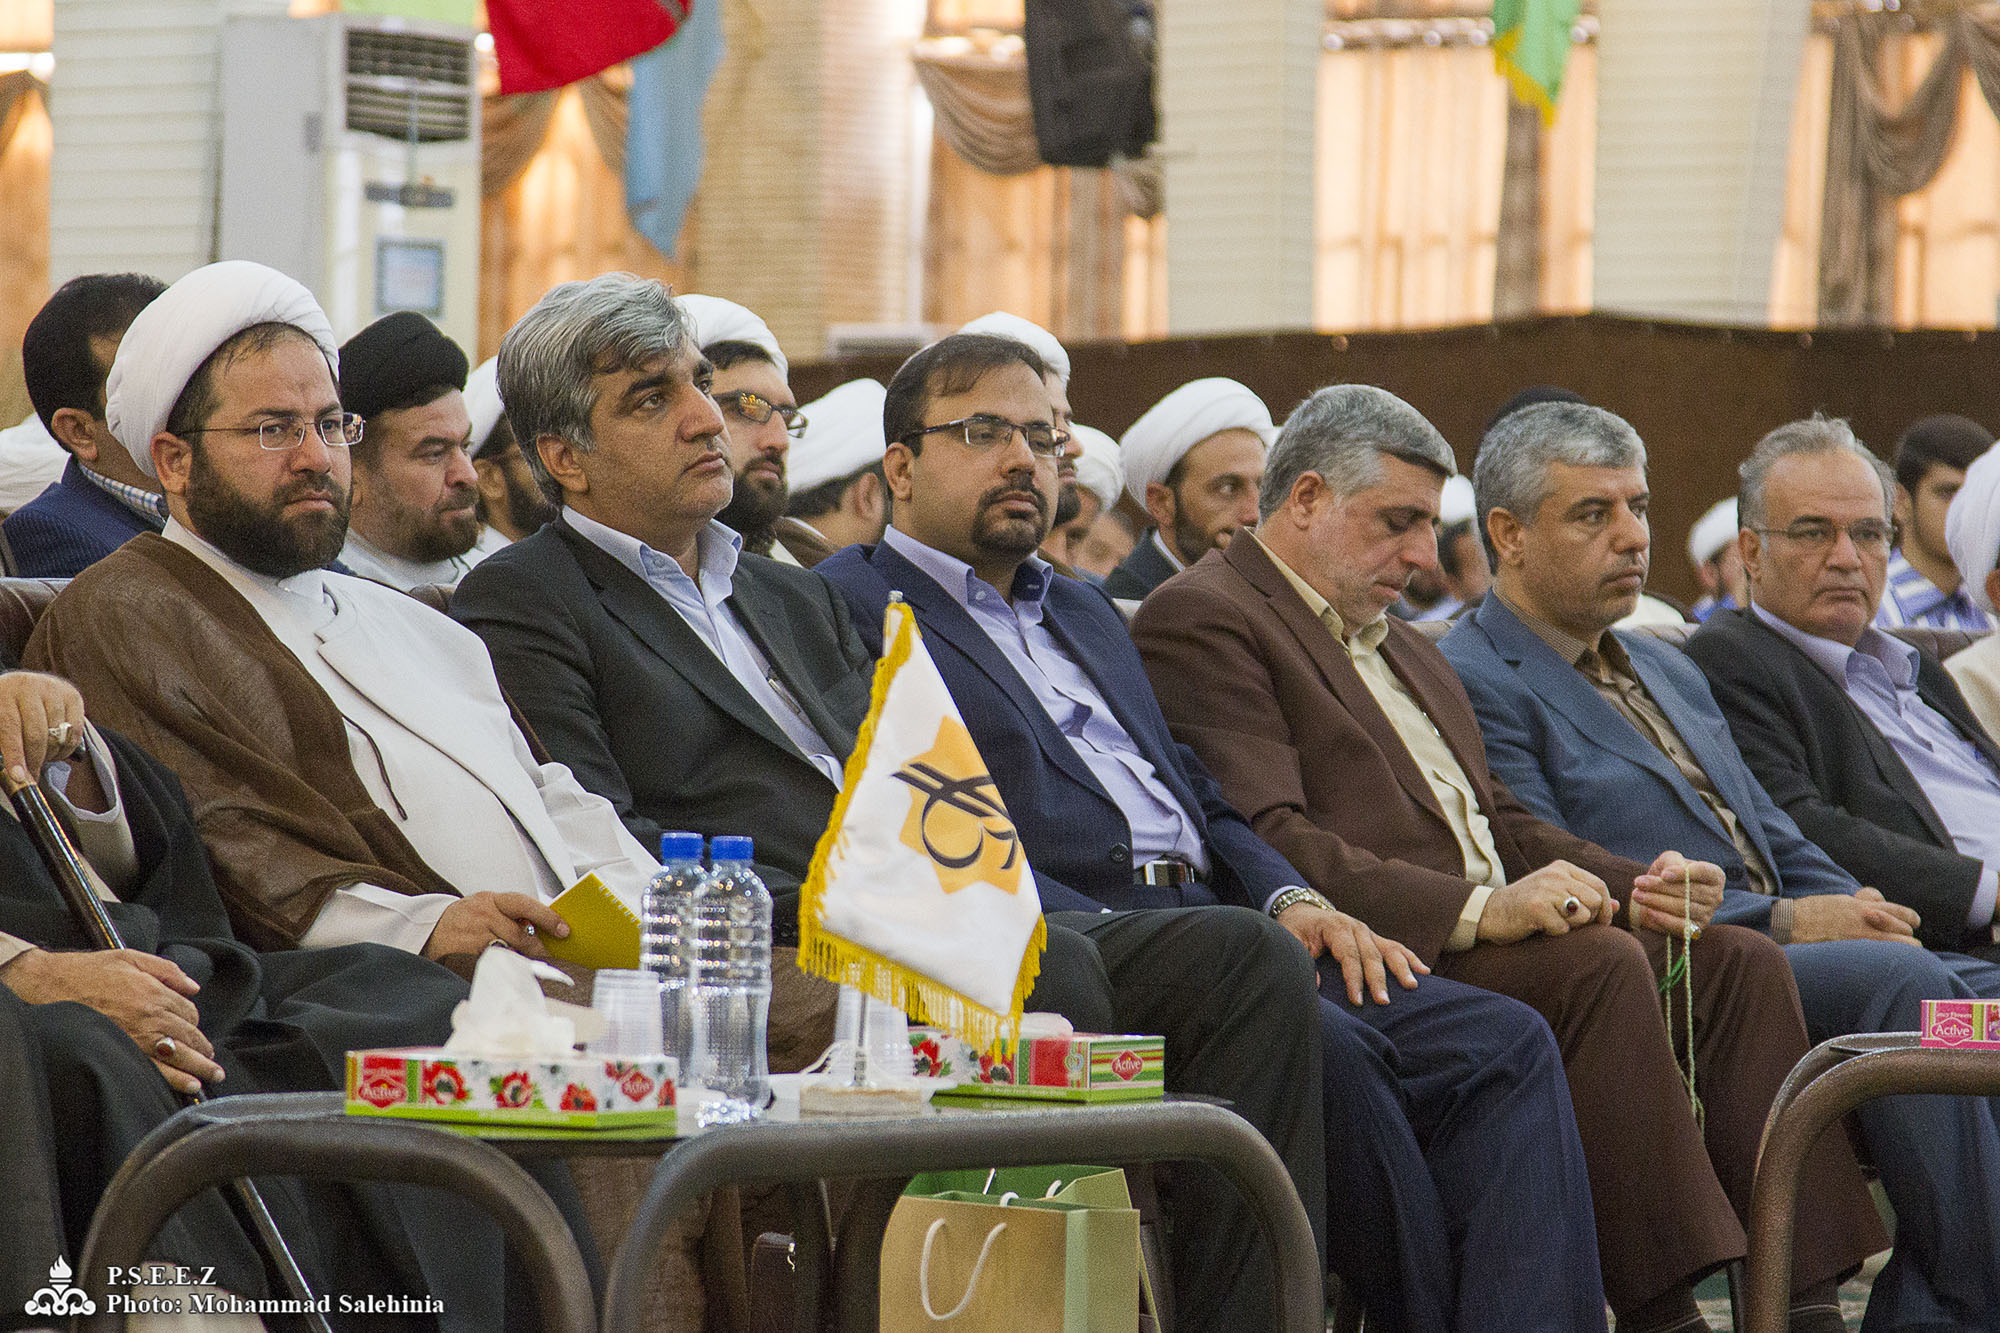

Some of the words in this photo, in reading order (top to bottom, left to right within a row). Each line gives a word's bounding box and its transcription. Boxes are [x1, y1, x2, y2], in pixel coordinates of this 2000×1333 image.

[1935, 1024, 1970, 1036] Active
[1114, 1056, 1141, 1072] Active
[362, 1082, 402, 1097] Active
